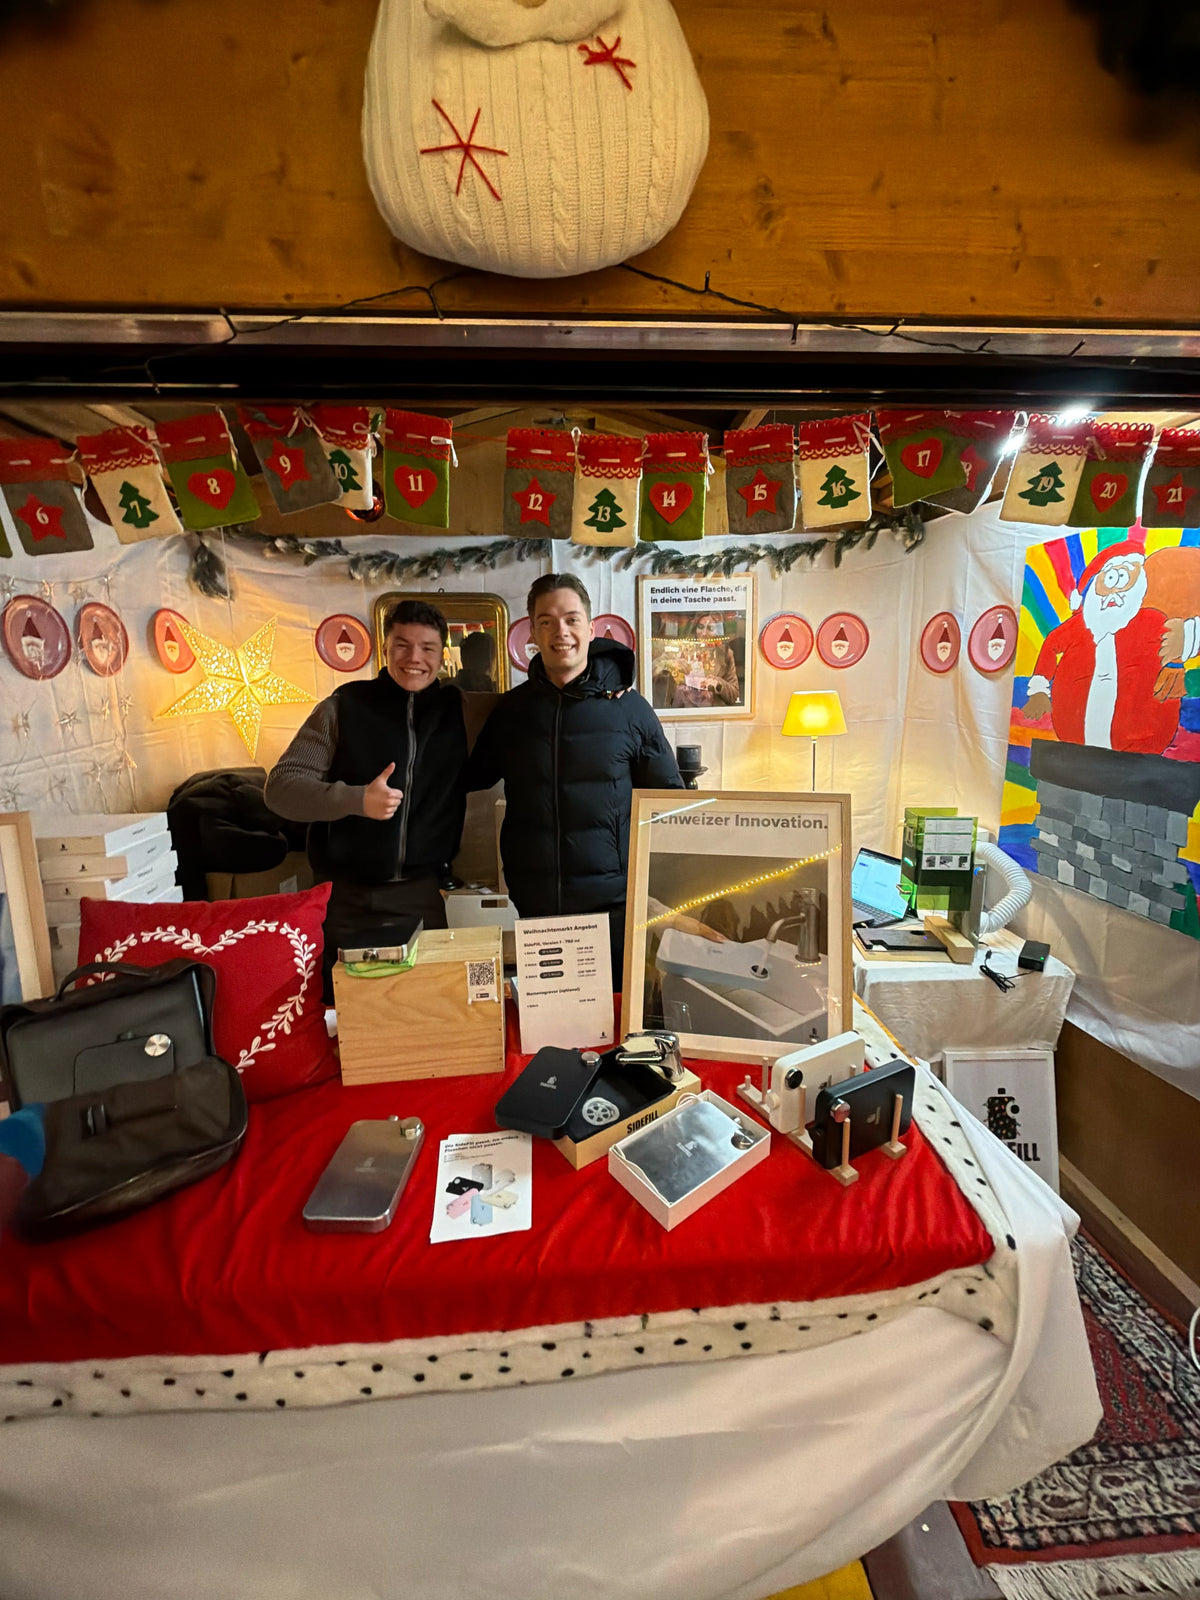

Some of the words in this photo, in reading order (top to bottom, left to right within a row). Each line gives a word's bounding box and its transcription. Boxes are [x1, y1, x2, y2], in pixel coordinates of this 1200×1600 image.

[279, 455, 292, 474] 9
[916, 449, 931, 468] 17
[333, 461, 348, 481] 10
[207, 477, 221, 496] 8
[408, 474, 424, 493] 11
[753, 483, 768, 501] 15
[830, 480, 846, 498] 16
[1036, 475, 1055, 493] 19
[1099, 482, 1118, 499] 20
[527, 492, 543, 511] 12
[661, 489, 677, 508] 14
[1167, 487, 1183, 504] 21
[36, 506, 49, 525] 6
[130, 500, 143, 519] 7
[597, 504, 611, 522] 13
[650, 586, 680, 594] Endlich
[681, 586, 699, 594] eine
[700, 585, 733, 594] Flasche,
[660, 596, 682, 604] deine
[712, 595, 737, 603] passt.
[650, 811, 730, 827] Schweizer
[735, 814, 829, 829] Innovation.
[523, 927, 573, 935] Weihnachtsmarkt
[626, 1110, 659, 1134] SIDEFILL
[1007, 1142, 1040, 1162] FILL
